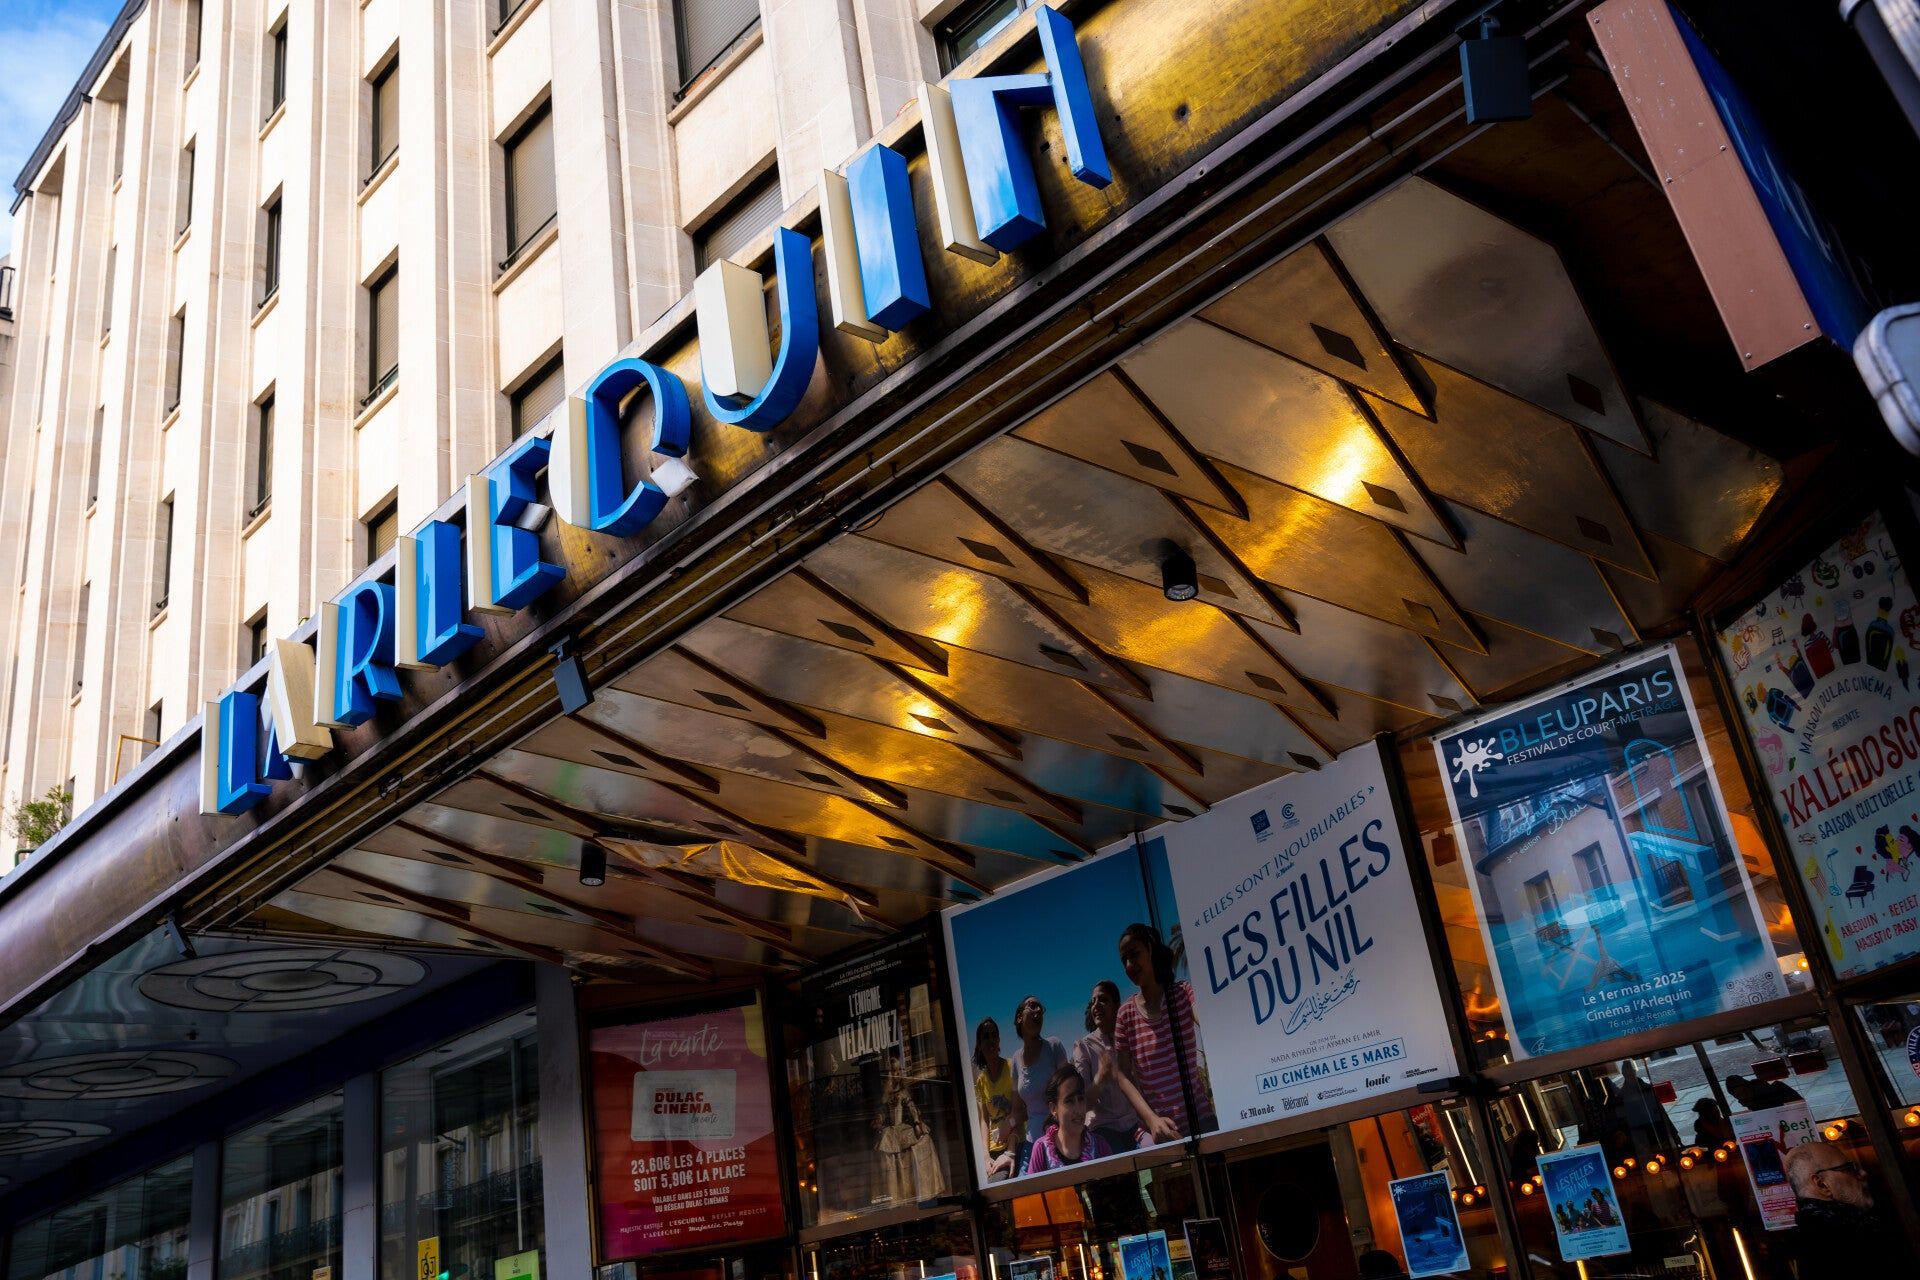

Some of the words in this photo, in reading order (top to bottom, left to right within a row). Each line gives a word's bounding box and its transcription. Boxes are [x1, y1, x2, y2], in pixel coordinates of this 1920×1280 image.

[1499, 669, 1675, 755] BLEUPARIS
[1799, 703, 1823, 755] MAISON
[1506, 740, 1558, 766] FESTIVAL
[1558, 733, 1576, 748] DE
[1818, 808, 1857, 841] SAISON
[1855, 774, 1916, 820] CULTURELLE
[1202, 891, 1235, 924] ELLES
[1234, 861, 1272, 899] SONT
[1273, 790, 1366, 869] INOUBLIABLES
[1204, 910, 1268, 995] LES
[1270, 818, 1391, 947] FILLES
[1247, 945, 1301, 1025] DU
[1305, 904, 1374, 986] NIL
[1582, 995, 1597, 1006] Le
[1598, 988, 1619, 1002] 1er
[1620, 982, 1652, 997] mars
[1652, 970, 1687, 989] 2025
[1586, 1004, 1632, 1022] Cinéma
[1607, 1019, 1620, 1029] 76
[1620, 1017, 1634, 1026] rue
[1635, 1013, 1647, 1023] de
[1646, 1008, 1678, 1021] Rennes
[639, 1028, 663, 1066] La
[668, 1022, 724, 1058] carte
[837, 1008, 900, 1062] VELÁZQUEZ
[1270, 1053, 1291, 1064] NADA
[1291, 1046, 1318, 1059] RIYADH
[1326, 1037, 1352, 1050] AYMAN
[1353, 1033, 1361, 1042] EL
[1362, 1029, 1382, 1040] AMIR
[1262, 1075, 1279, 1090] AU
[1282, 1063, 1331, 1084] CINÉMA
[1333, 1057, 1348, 1072] LE
[1352, 1054, 1360, 1067] 5
[1362, 1043, 1401, 1064] MARS
[1365, 1072, 1392, 1089] louie
[653, 1102, 713, 1115] CINÉMA
[654, 1091, 705, 1103] DULAC
[1240, 1111, 1248, 1120] Le
[1248, 1104, 1276, 1118] Monde
[1779, 1117, 1811, 1133] Best
[631, 1155, 671, 1175] 23,60€
[673, 1154, 693, 1169] LES
[695, 1150, 704, 1165] 4
[706, 1146, 746, 1164] PLACES
[634, 1176, 658, 1192] SOIT
[660, 1169, 694, 1190] 5,90€
[696, 1168, 710, 1183] LA
[711, 1163, 746, 1181] PLACE
[1555, 1175, 1570, 1192] LES
[1569, 1161, 1595, 1185] FILLES
[1565, 1185, 1578, 1199] DU
[1578, 1177, 1592, 1193] NIL
[651, 1192, 677, 1205] VALABLE
[677, 1191, 693, 1201] DANS
[692, 1189, 703, 1199] LES
[709, 1186, 731, 1197] SALLES
[655, 1205, 663, 1213] DU
[685, 1199, 704, 1209] DULAC
[703, 1195, 730, 1207] CINÉMAS
